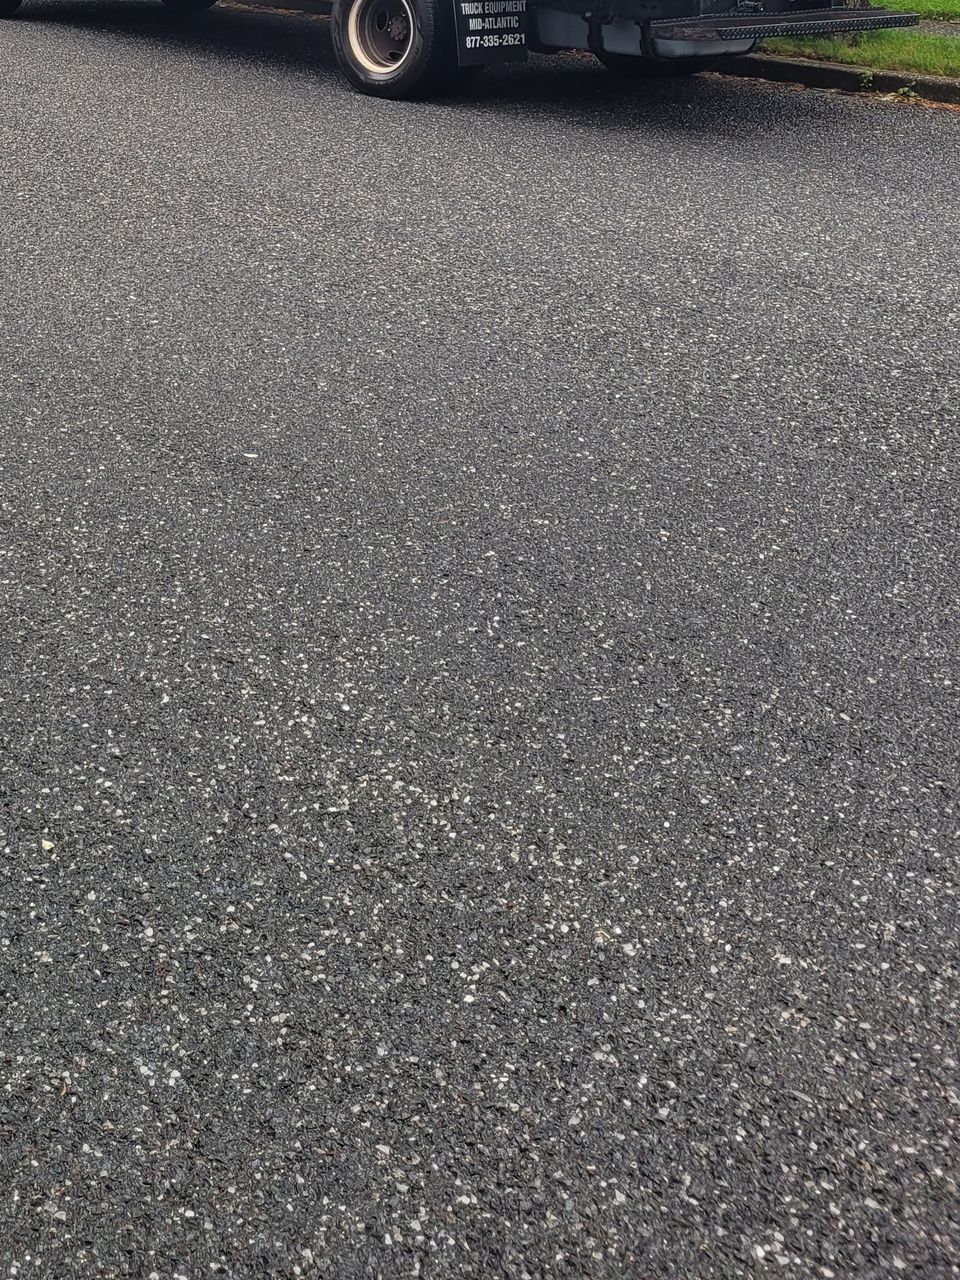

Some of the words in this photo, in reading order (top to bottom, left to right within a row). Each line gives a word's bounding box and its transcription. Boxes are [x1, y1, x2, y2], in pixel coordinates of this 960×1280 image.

[461, 2, 483, 15] TRUCK
[485, 0, 527, 15] EQUIPMENT
[469, 16, 519, 30] MID-ATLANTIC
[466, 33, 526, 49] 877-335-2621
